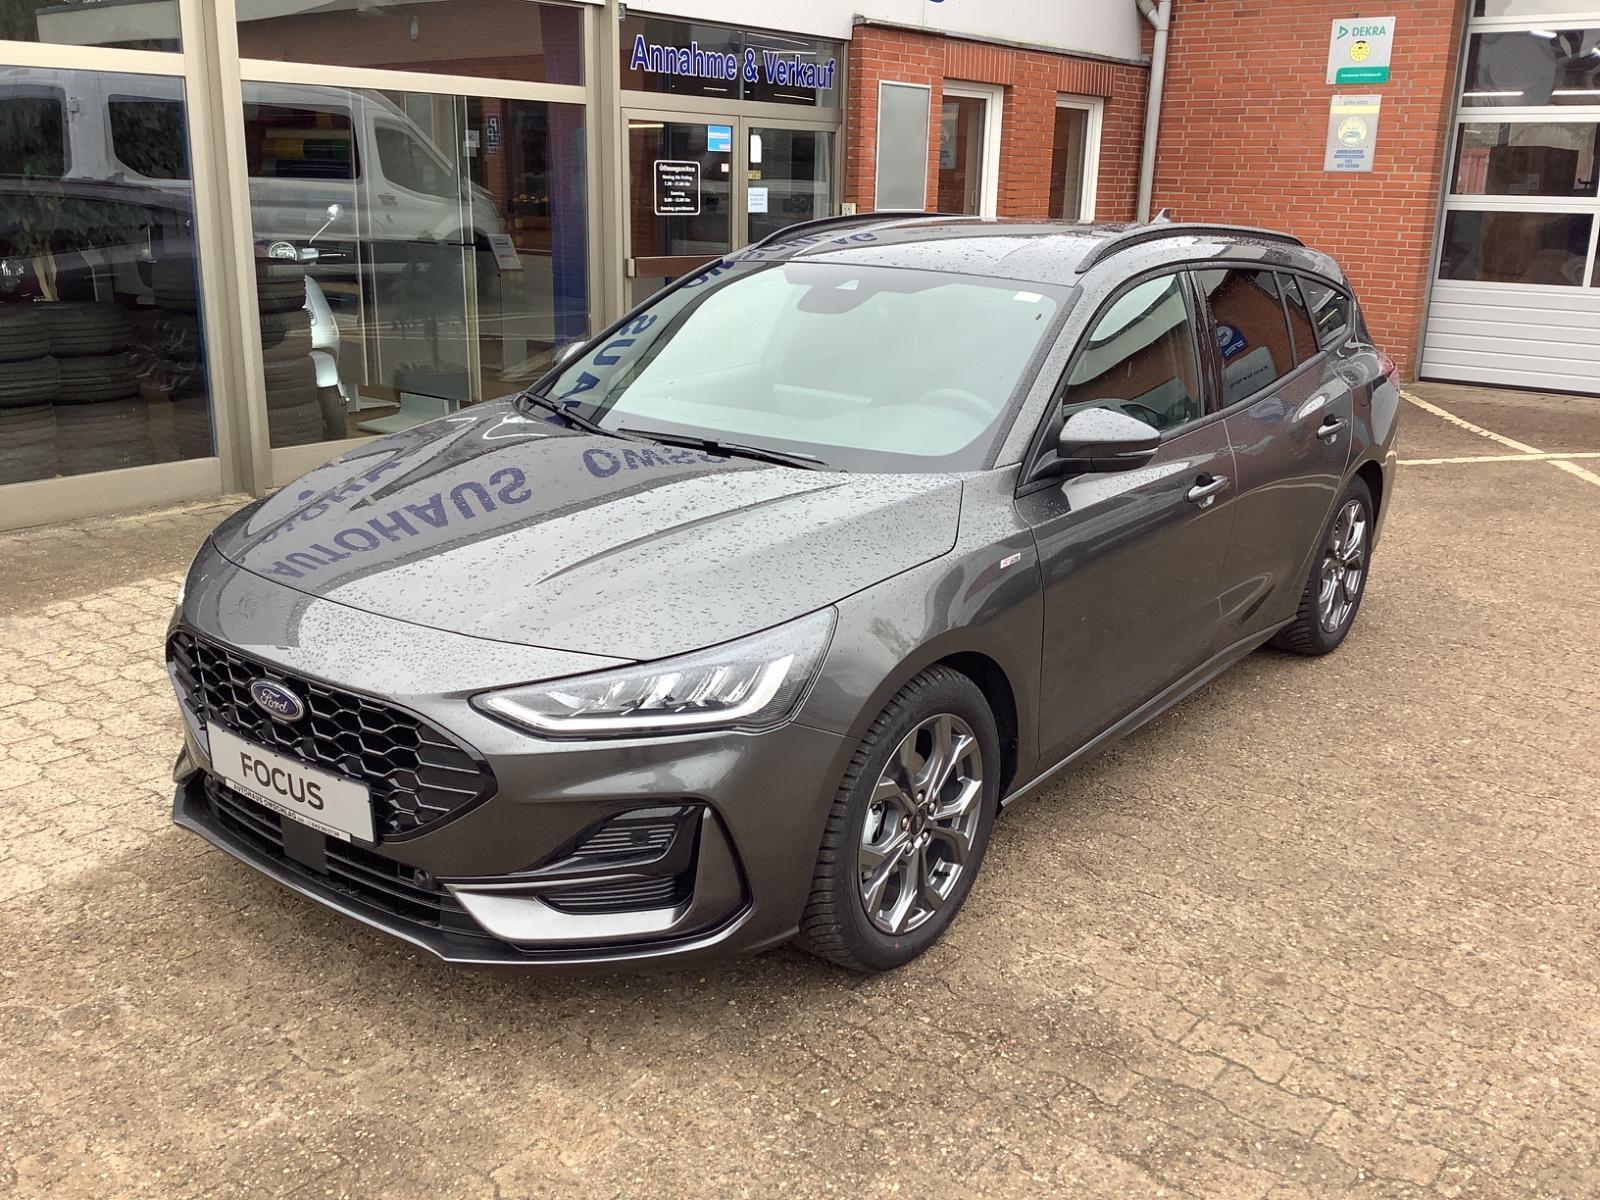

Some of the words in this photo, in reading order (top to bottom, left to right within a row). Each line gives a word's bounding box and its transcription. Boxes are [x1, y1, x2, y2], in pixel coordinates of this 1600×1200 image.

[1351, 25, 1386, 37] DEKRA
[630, 34, 737, 80] Annahme
[743, 48, 759, 84] &
[763, 50, 836, 90] Verkauf
[260, 688, 288, 713] Ford
[240, 752, 324, 811] FOCUS
